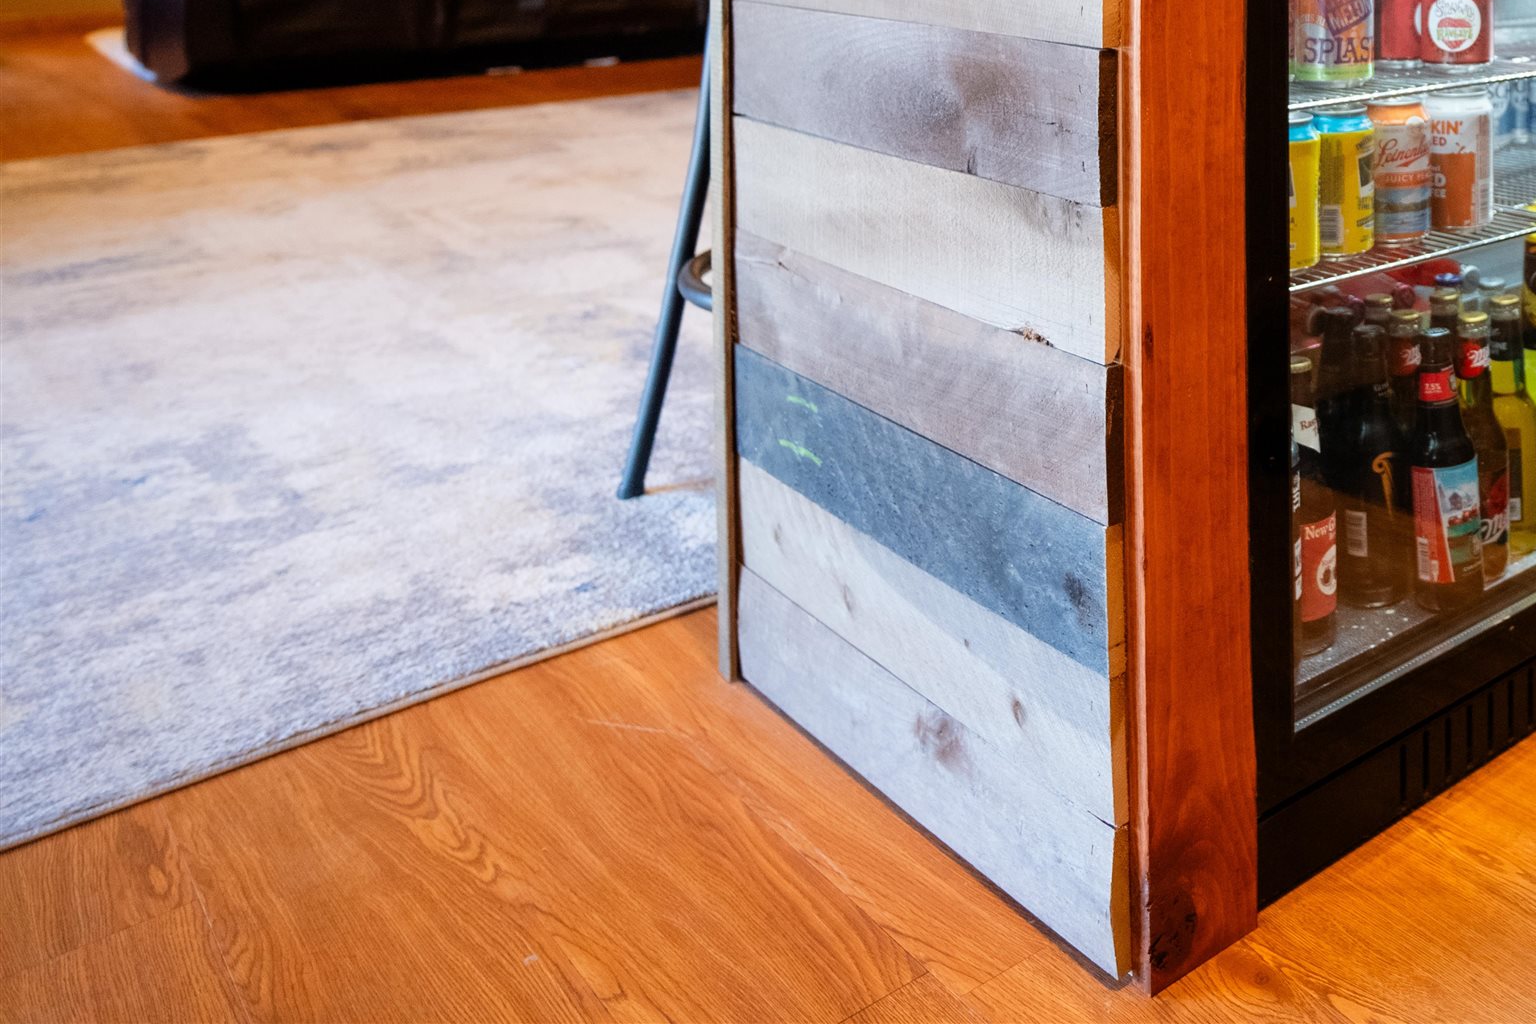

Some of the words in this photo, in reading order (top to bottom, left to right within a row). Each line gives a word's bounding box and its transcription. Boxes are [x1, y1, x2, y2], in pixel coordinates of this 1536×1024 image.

[1303, 37, 1374, 64] SPLAS
[1386, 174, 1414, 183] JUICY
[1305, 525, 1328, 540] New
